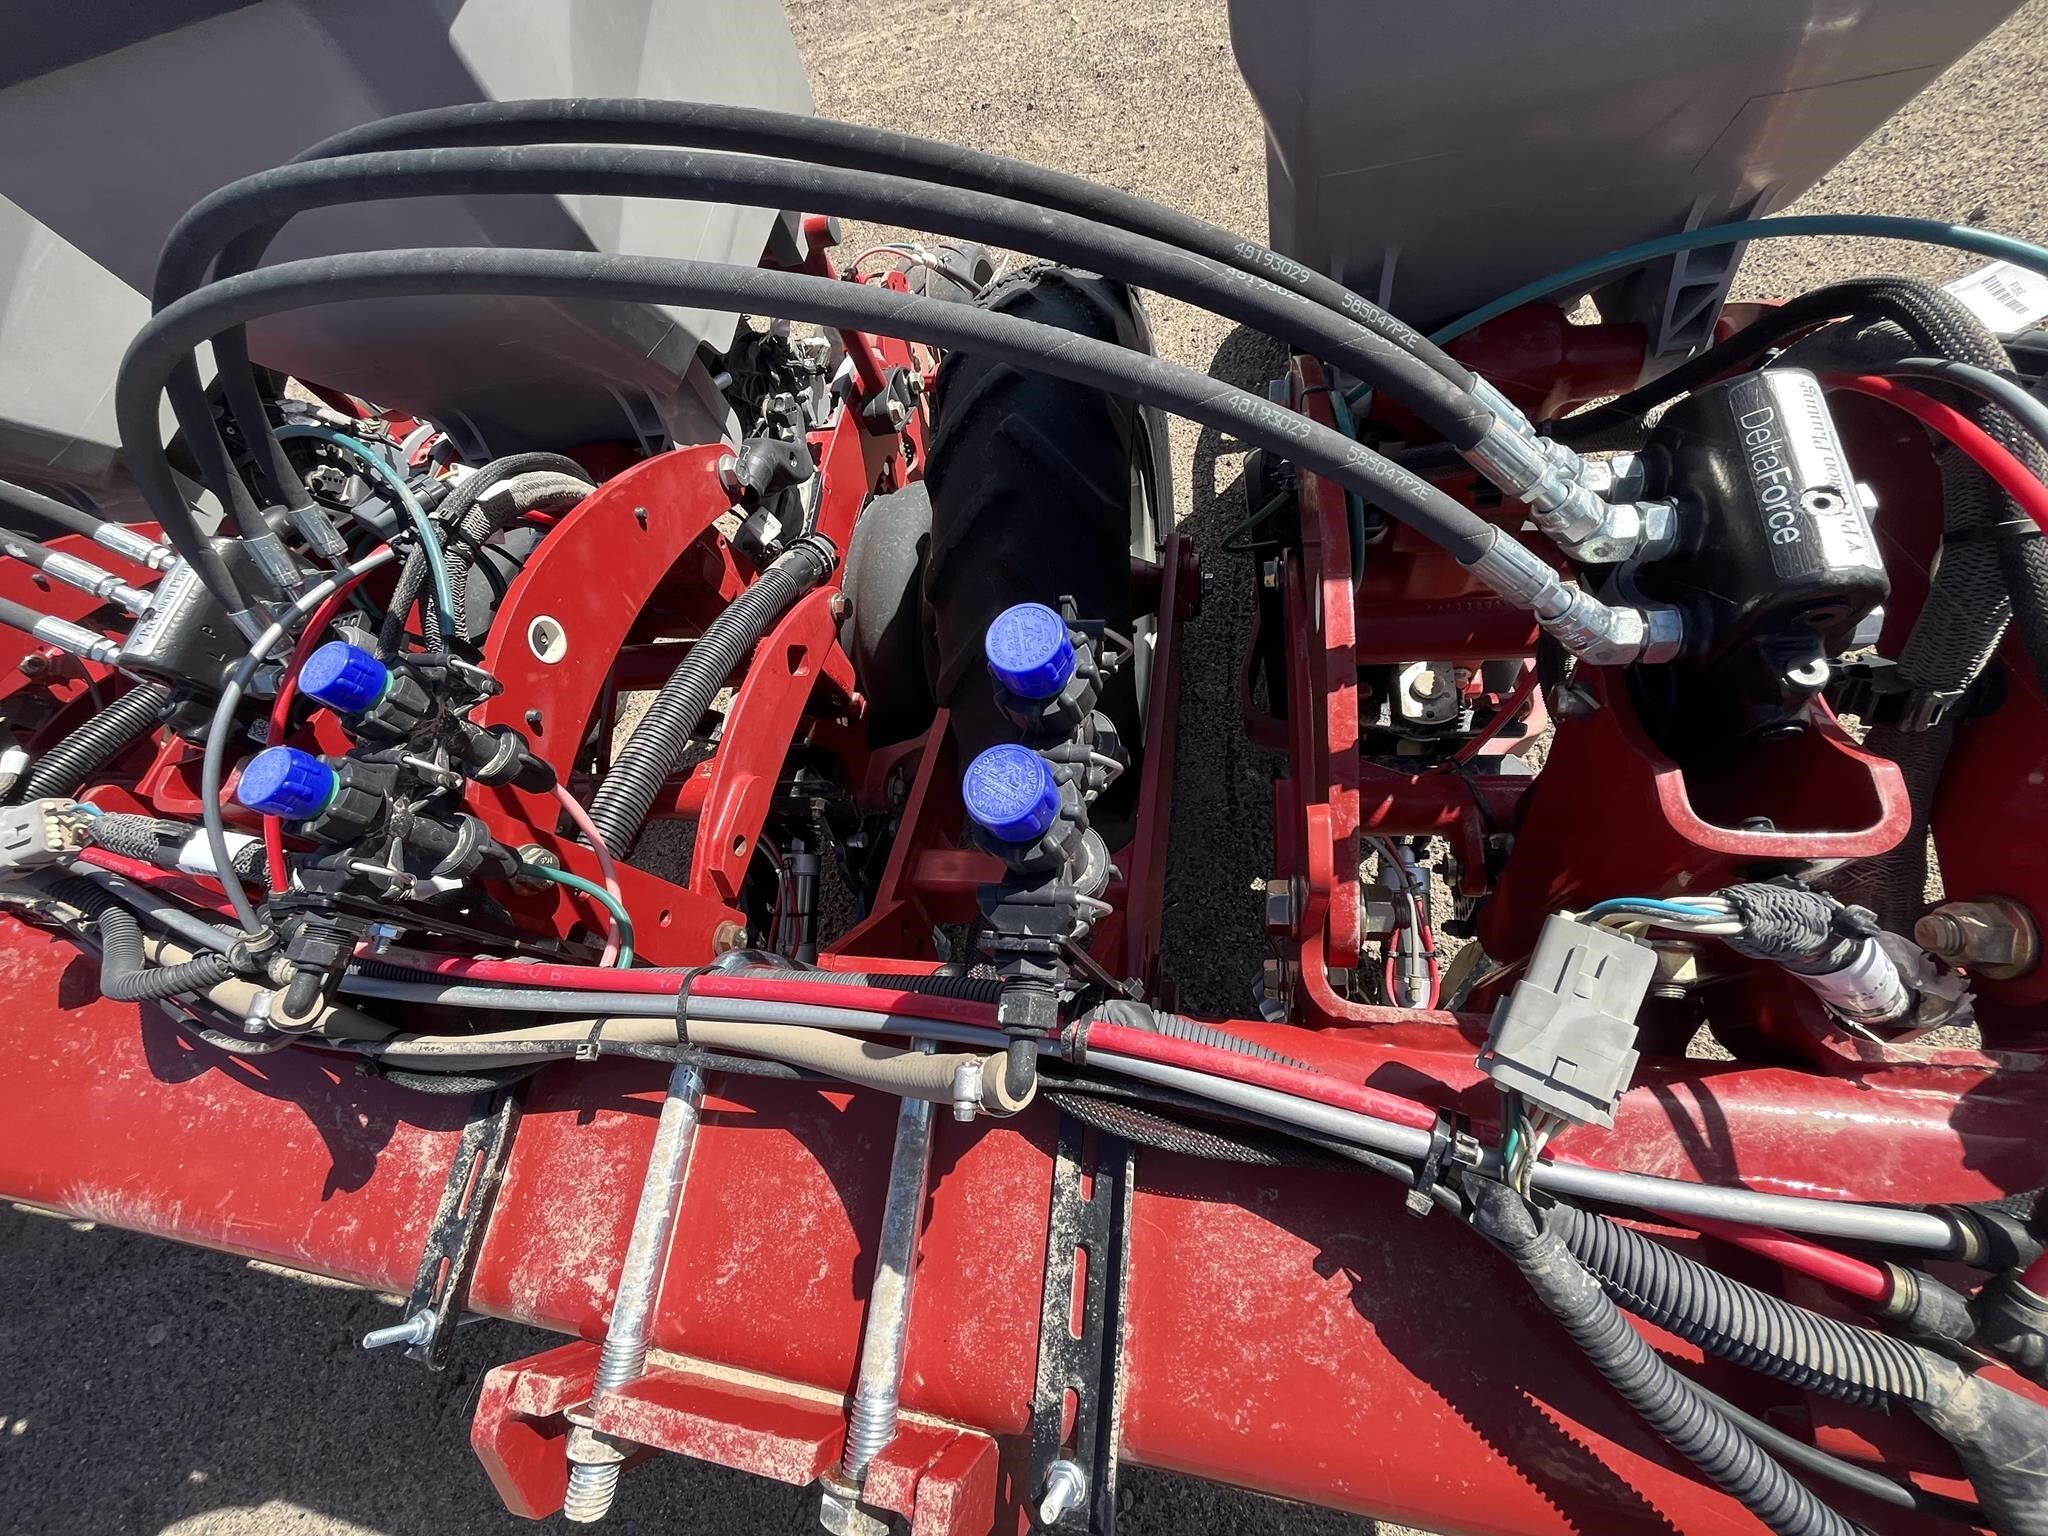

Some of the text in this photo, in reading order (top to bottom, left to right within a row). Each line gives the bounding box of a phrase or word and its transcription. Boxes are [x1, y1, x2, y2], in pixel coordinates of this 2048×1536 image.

[1234, 241, 1311, 284] 48193029
[1341, 292, 1421, 349] 585047P2E
[1228, 393, 1432, 501] 48193029 585047P2E
[1740, 406, 1800, 546] DeltaForce
